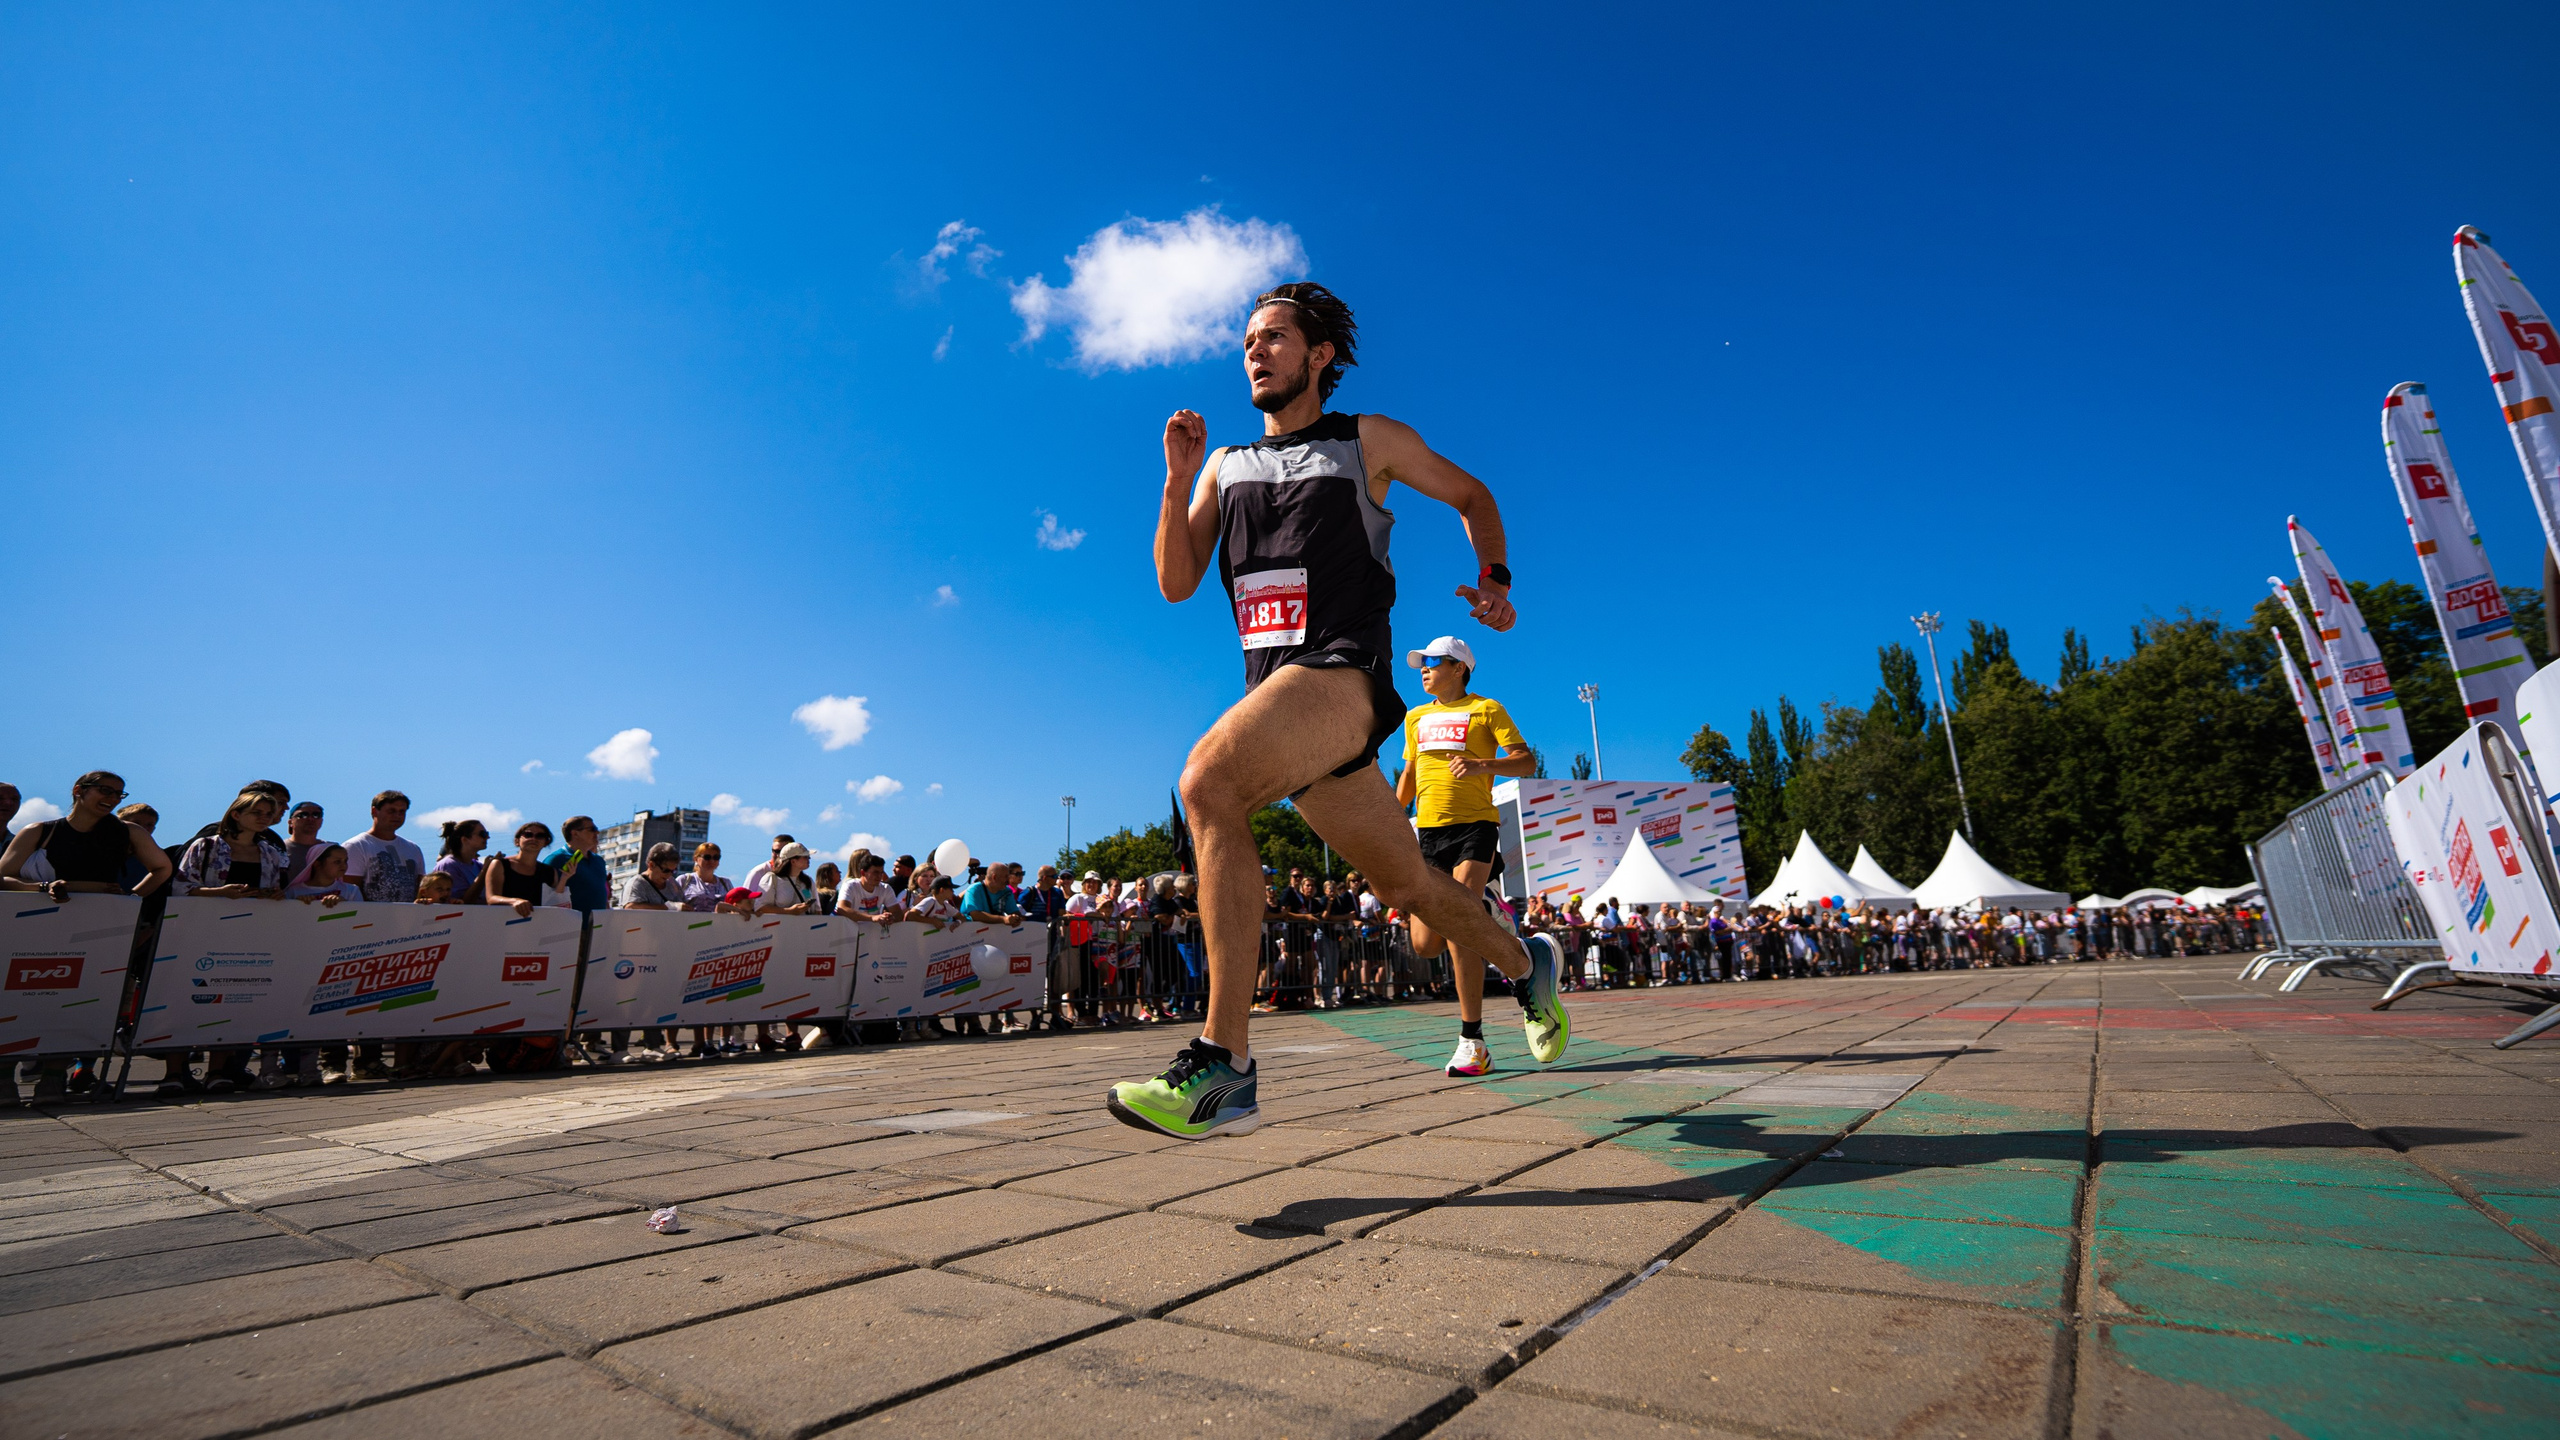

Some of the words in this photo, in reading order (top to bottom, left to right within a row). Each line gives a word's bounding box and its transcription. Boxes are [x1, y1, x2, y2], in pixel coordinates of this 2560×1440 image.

[1248, 600, 1303, 628] 1817
[1429, 727, 1465, 740] 3043
[331, 928, 451, 955] СПОРТИВНО-МУЗЫКАЛЬНЫЙ
[325, 947, 441, 983] ДОСТИГАЯ
[327, 950, 375, 964] ПРАЗДНИК
[692, 950, 766, 978] ДОСТИГАЯ
[928, 954, 971, 977] ДОСТИГ
[361, 963, 435, 990] ЦЕЛИ!
[715, 962, 762, 985] ЦЕЛИ!
[313, 988, 351, 1001] СЕМЬИ
[315, 985, 332, 994] ДЛЯ
[333, 981, 353, 991] ВСЕЙ
